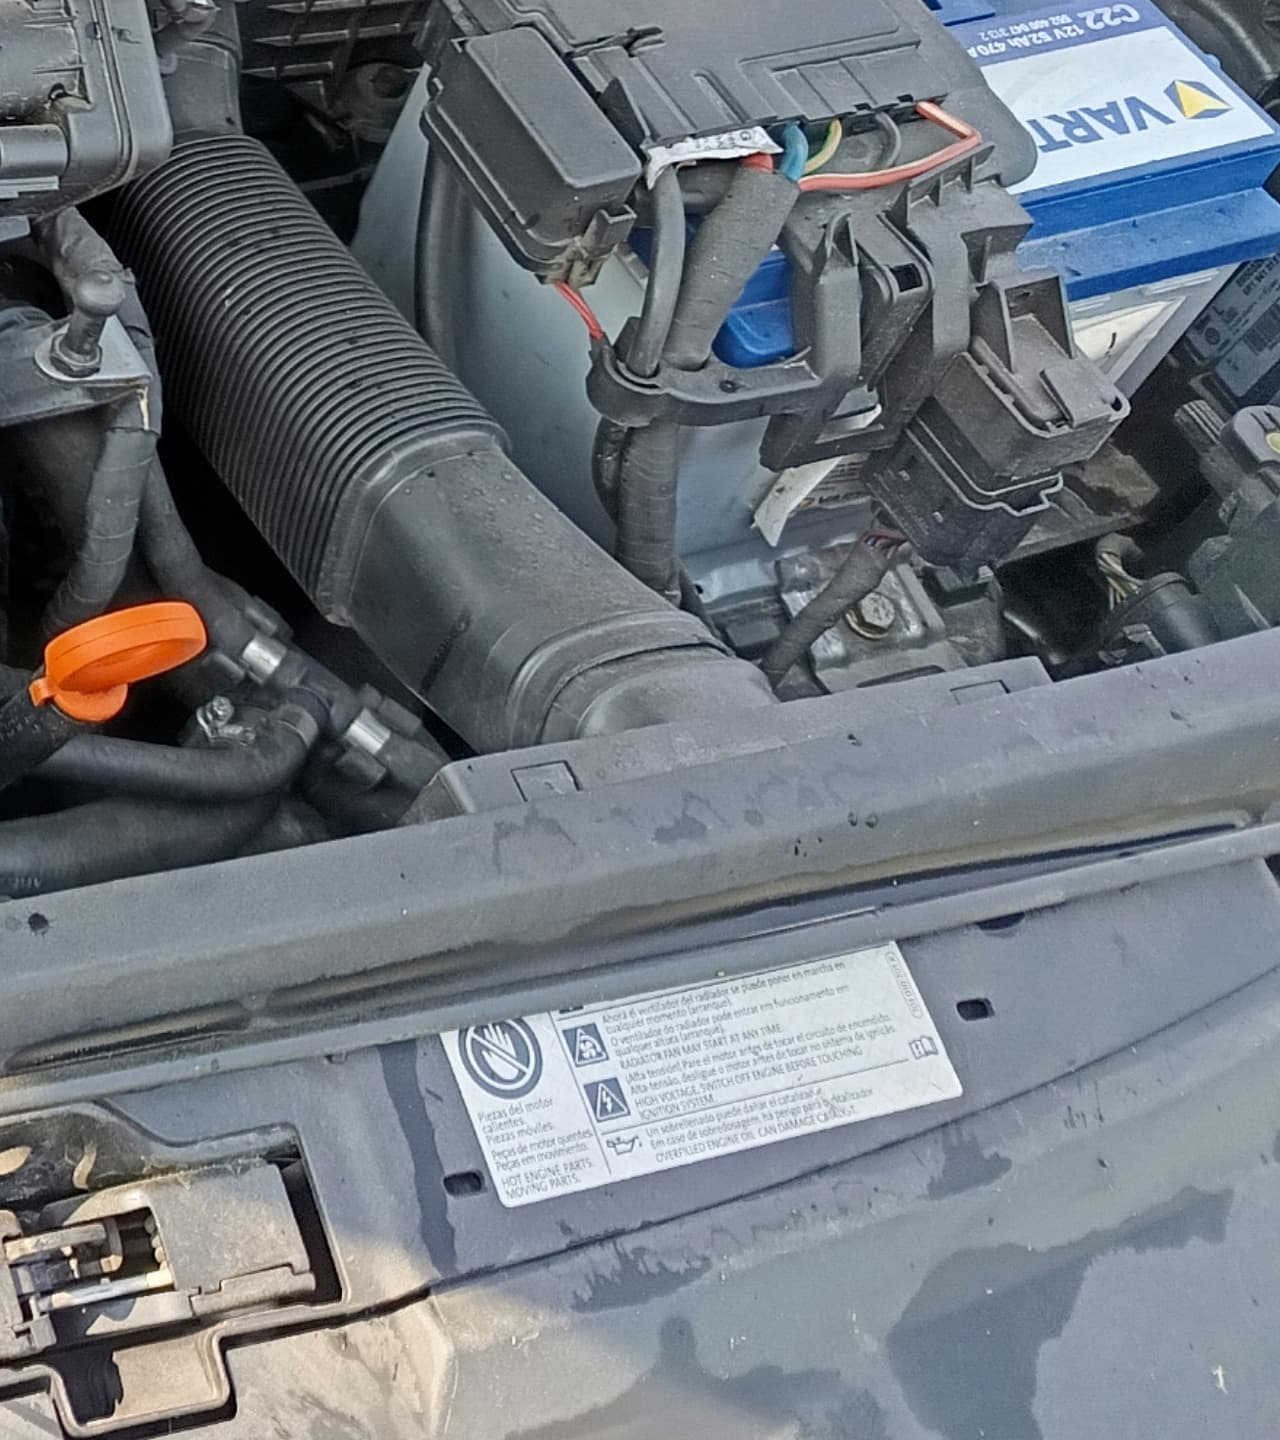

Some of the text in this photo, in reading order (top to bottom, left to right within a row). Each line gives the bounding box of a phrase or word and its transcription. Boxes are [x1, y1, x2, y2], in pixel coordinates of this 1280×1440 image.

[1078, 3, 1140, 30] C22
[1008, 31, 1051, 50] 52Ah
[1053, 25, 1085, 40] 12V
[619, 1050, 664, 1070] RADIATOR
[663, 1046, 681, 1059] FAN
[680, 1041, 703, 1055] MAY
[702, 1035, 727, 1050] START
[728, 1032, 741, 1044] AT
[741, 1027, 759, 1041] ANY
[634, 1094, 658, 1109] HIGH
[700, 1076, 734, 1093] SWITCH
[734, 1072, 750, 1085] OFF
[751, 1063, 784, 1081] ENGINE
[784, 1056, 817, 1073] BEFORE
[816, 1044, 863, 1065] TOUCHING
[477, 1094, 553, 1123] Piezas del motor
[638, 1101, 681, 1121] IGNITION
[484, 1128, 516, 1146] Piezas
[490, 1145, 517, 1161] Peças
[515, 1142, 528, 1155] de
[528, 1136, 556, 1152] motor
[495, 1157, 521, 1174] Peças
[519, 1153, 536, 1166] em
[500, 1173, 522, 1188] HOT
[523, 1164, 561, 1183] ENGINE
[504, 1179, 548, 1200] MOVING
